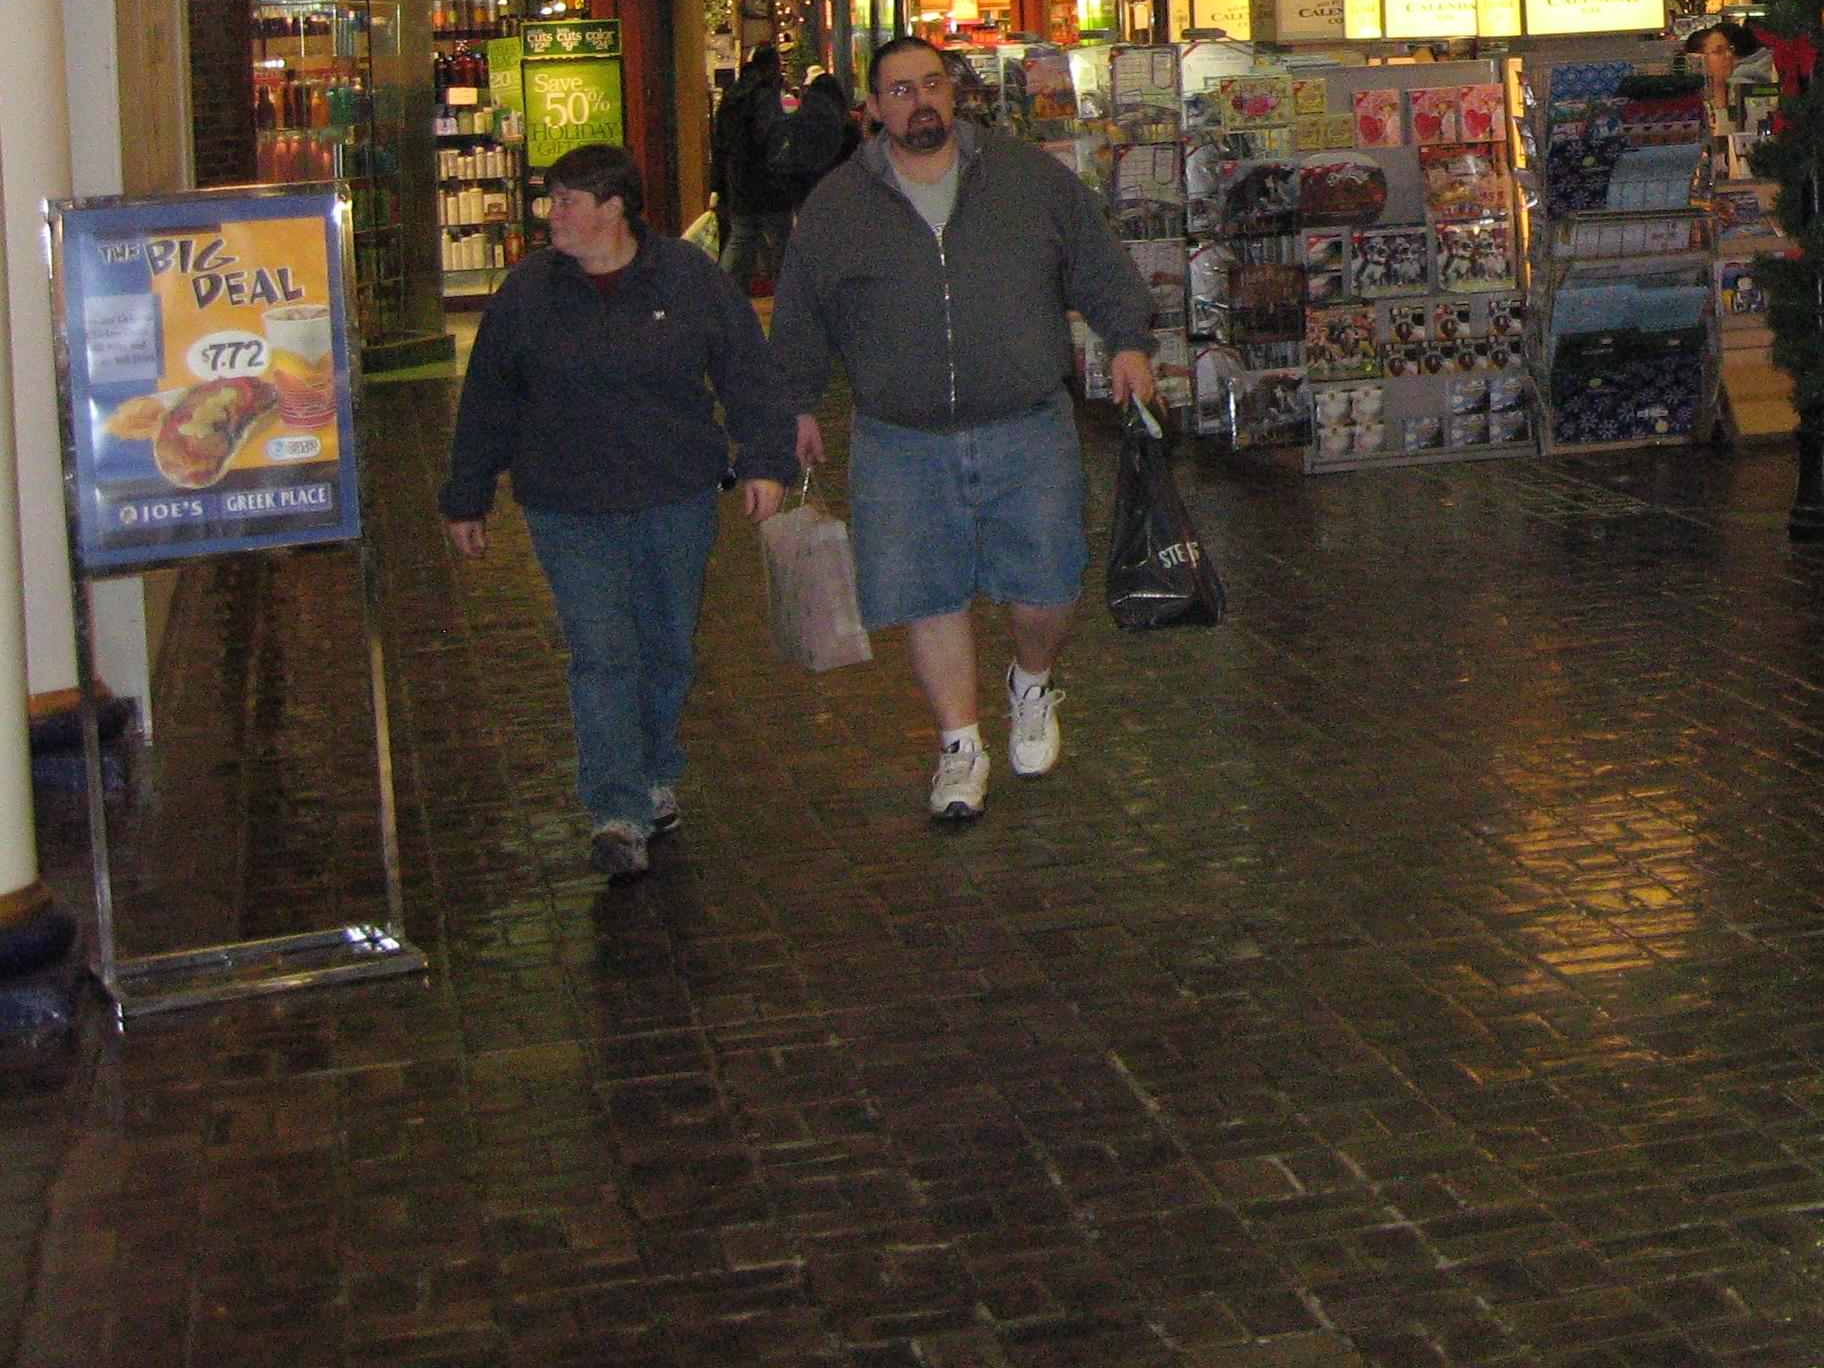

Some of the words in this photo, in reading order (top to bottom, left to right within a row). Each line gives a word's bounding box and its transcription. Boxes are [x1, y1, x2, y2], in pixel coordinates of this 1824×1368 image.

[1299, 8, 1344, 19] CALEN
[1405, 1, 1477, 14] CALENDA
[534, 73, 584, 93] Save
[545, 91, 610, 128] 50%
[532, 122, 618, 141] HOLIDAY
[144, 238, 240, 276] BIG
[193, 267, 305, 310] DEAL
[202, 339, 265, 371] $7.72
[226, 491, 277, 512] GREEK
[279, 487, 328, 507] PLACE
